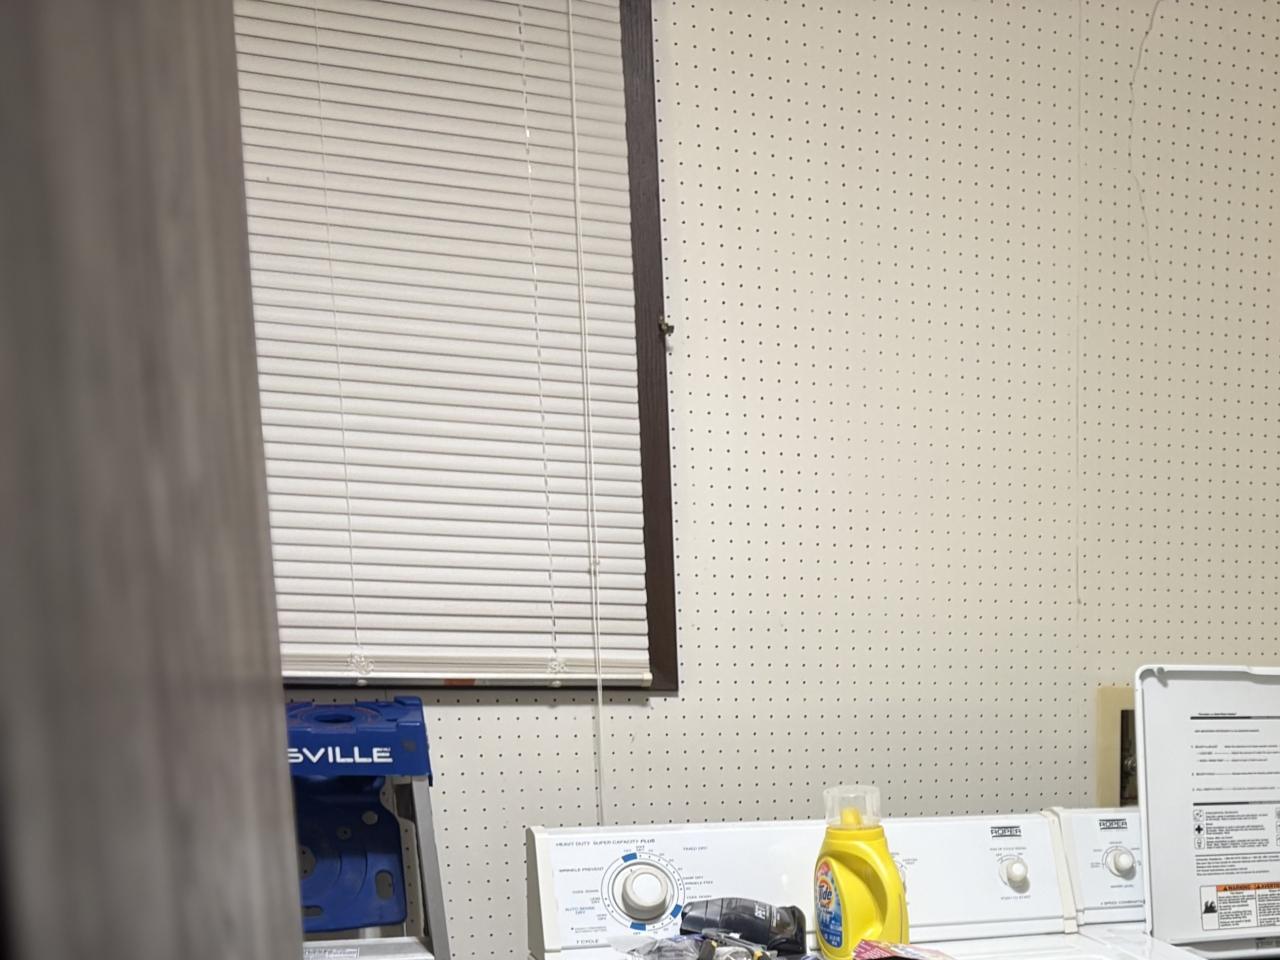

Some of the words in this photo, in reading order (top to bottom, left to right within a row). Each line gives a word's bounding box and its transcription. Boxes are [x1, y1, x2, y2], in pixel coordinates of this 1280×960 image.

[288, 745, 394, 764] SVILLE
[1098, 820, 1128, 829] ROPER
[990, 827, 1022, 837] ROPER
[818, 884, 833, 901] Tide
